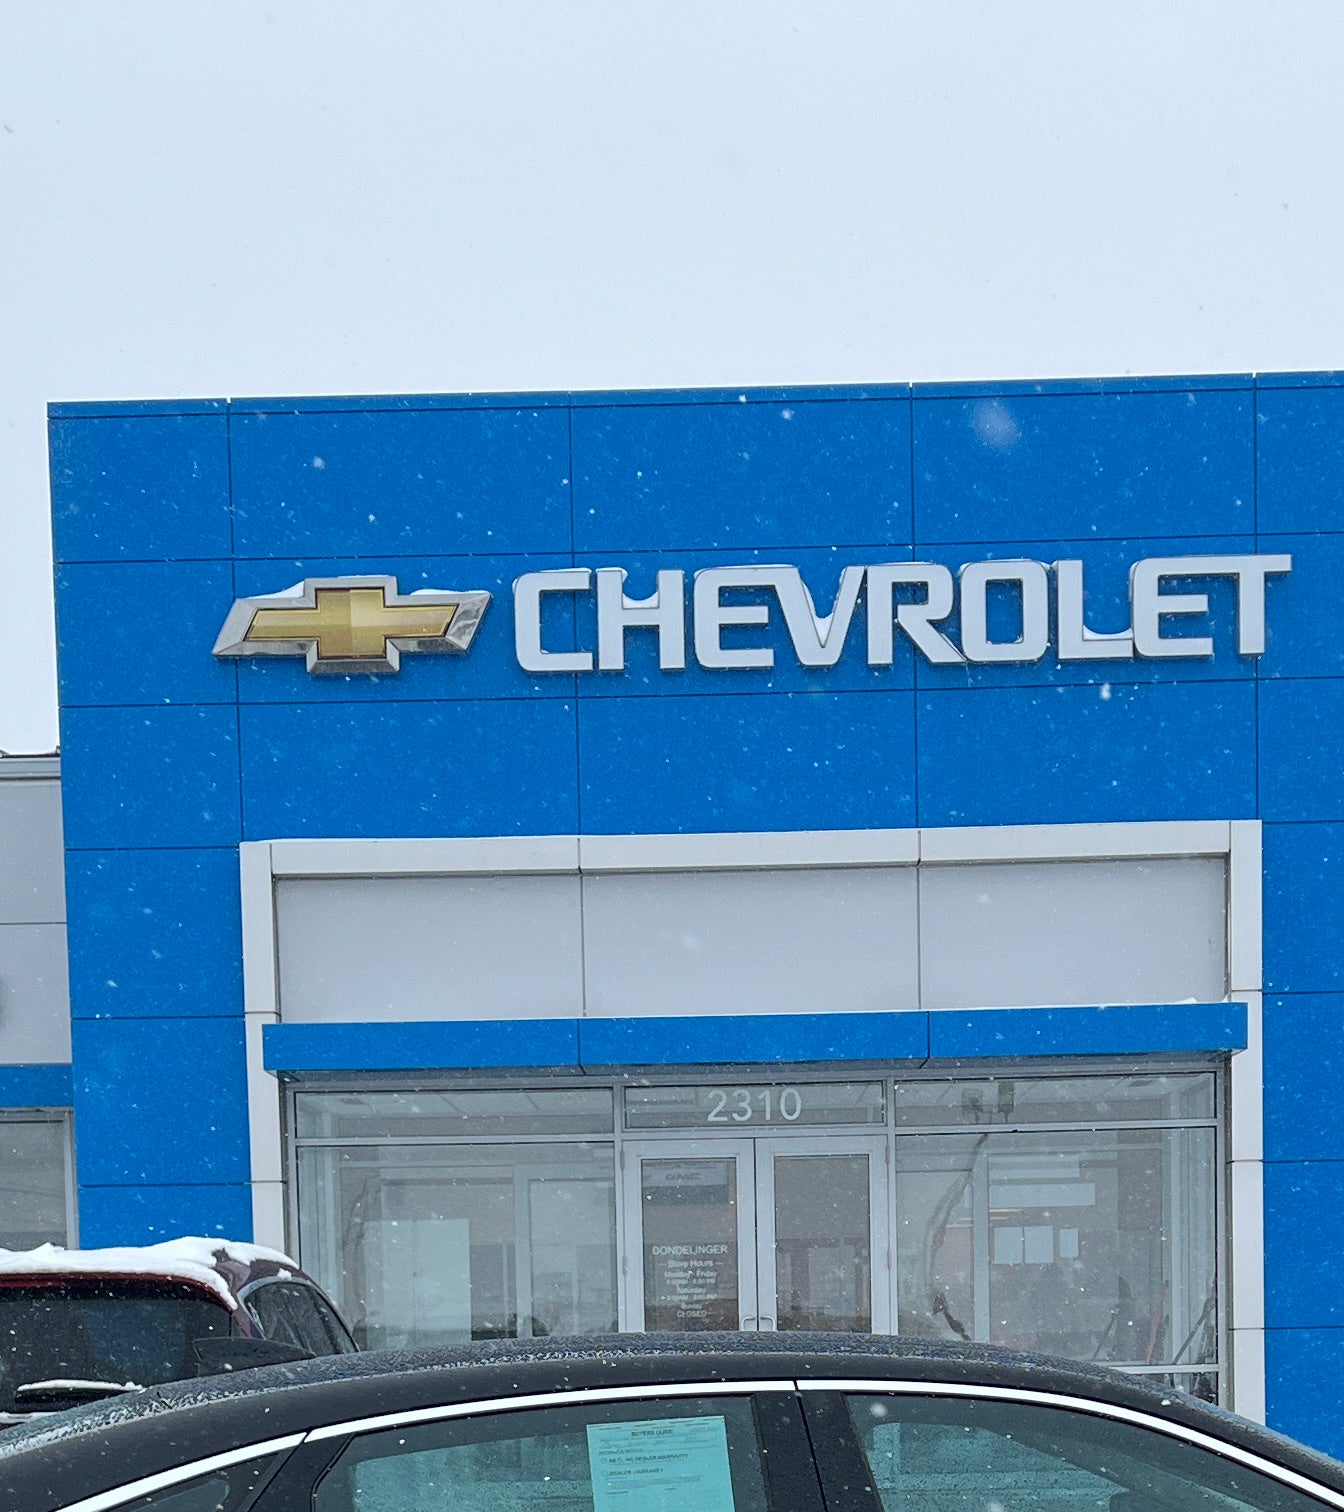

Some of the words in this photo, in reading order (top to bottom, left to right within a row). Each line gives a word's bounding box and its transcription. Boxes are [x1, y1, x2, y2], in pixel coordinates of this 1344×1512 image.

[513, 553, 1293, 673] CHEVROLET
[706, 1088, 802, 1122] 2310
[652, 1245, 729, 1256] DONDELINGER
[690, 1259, 714, 1268] Hours
